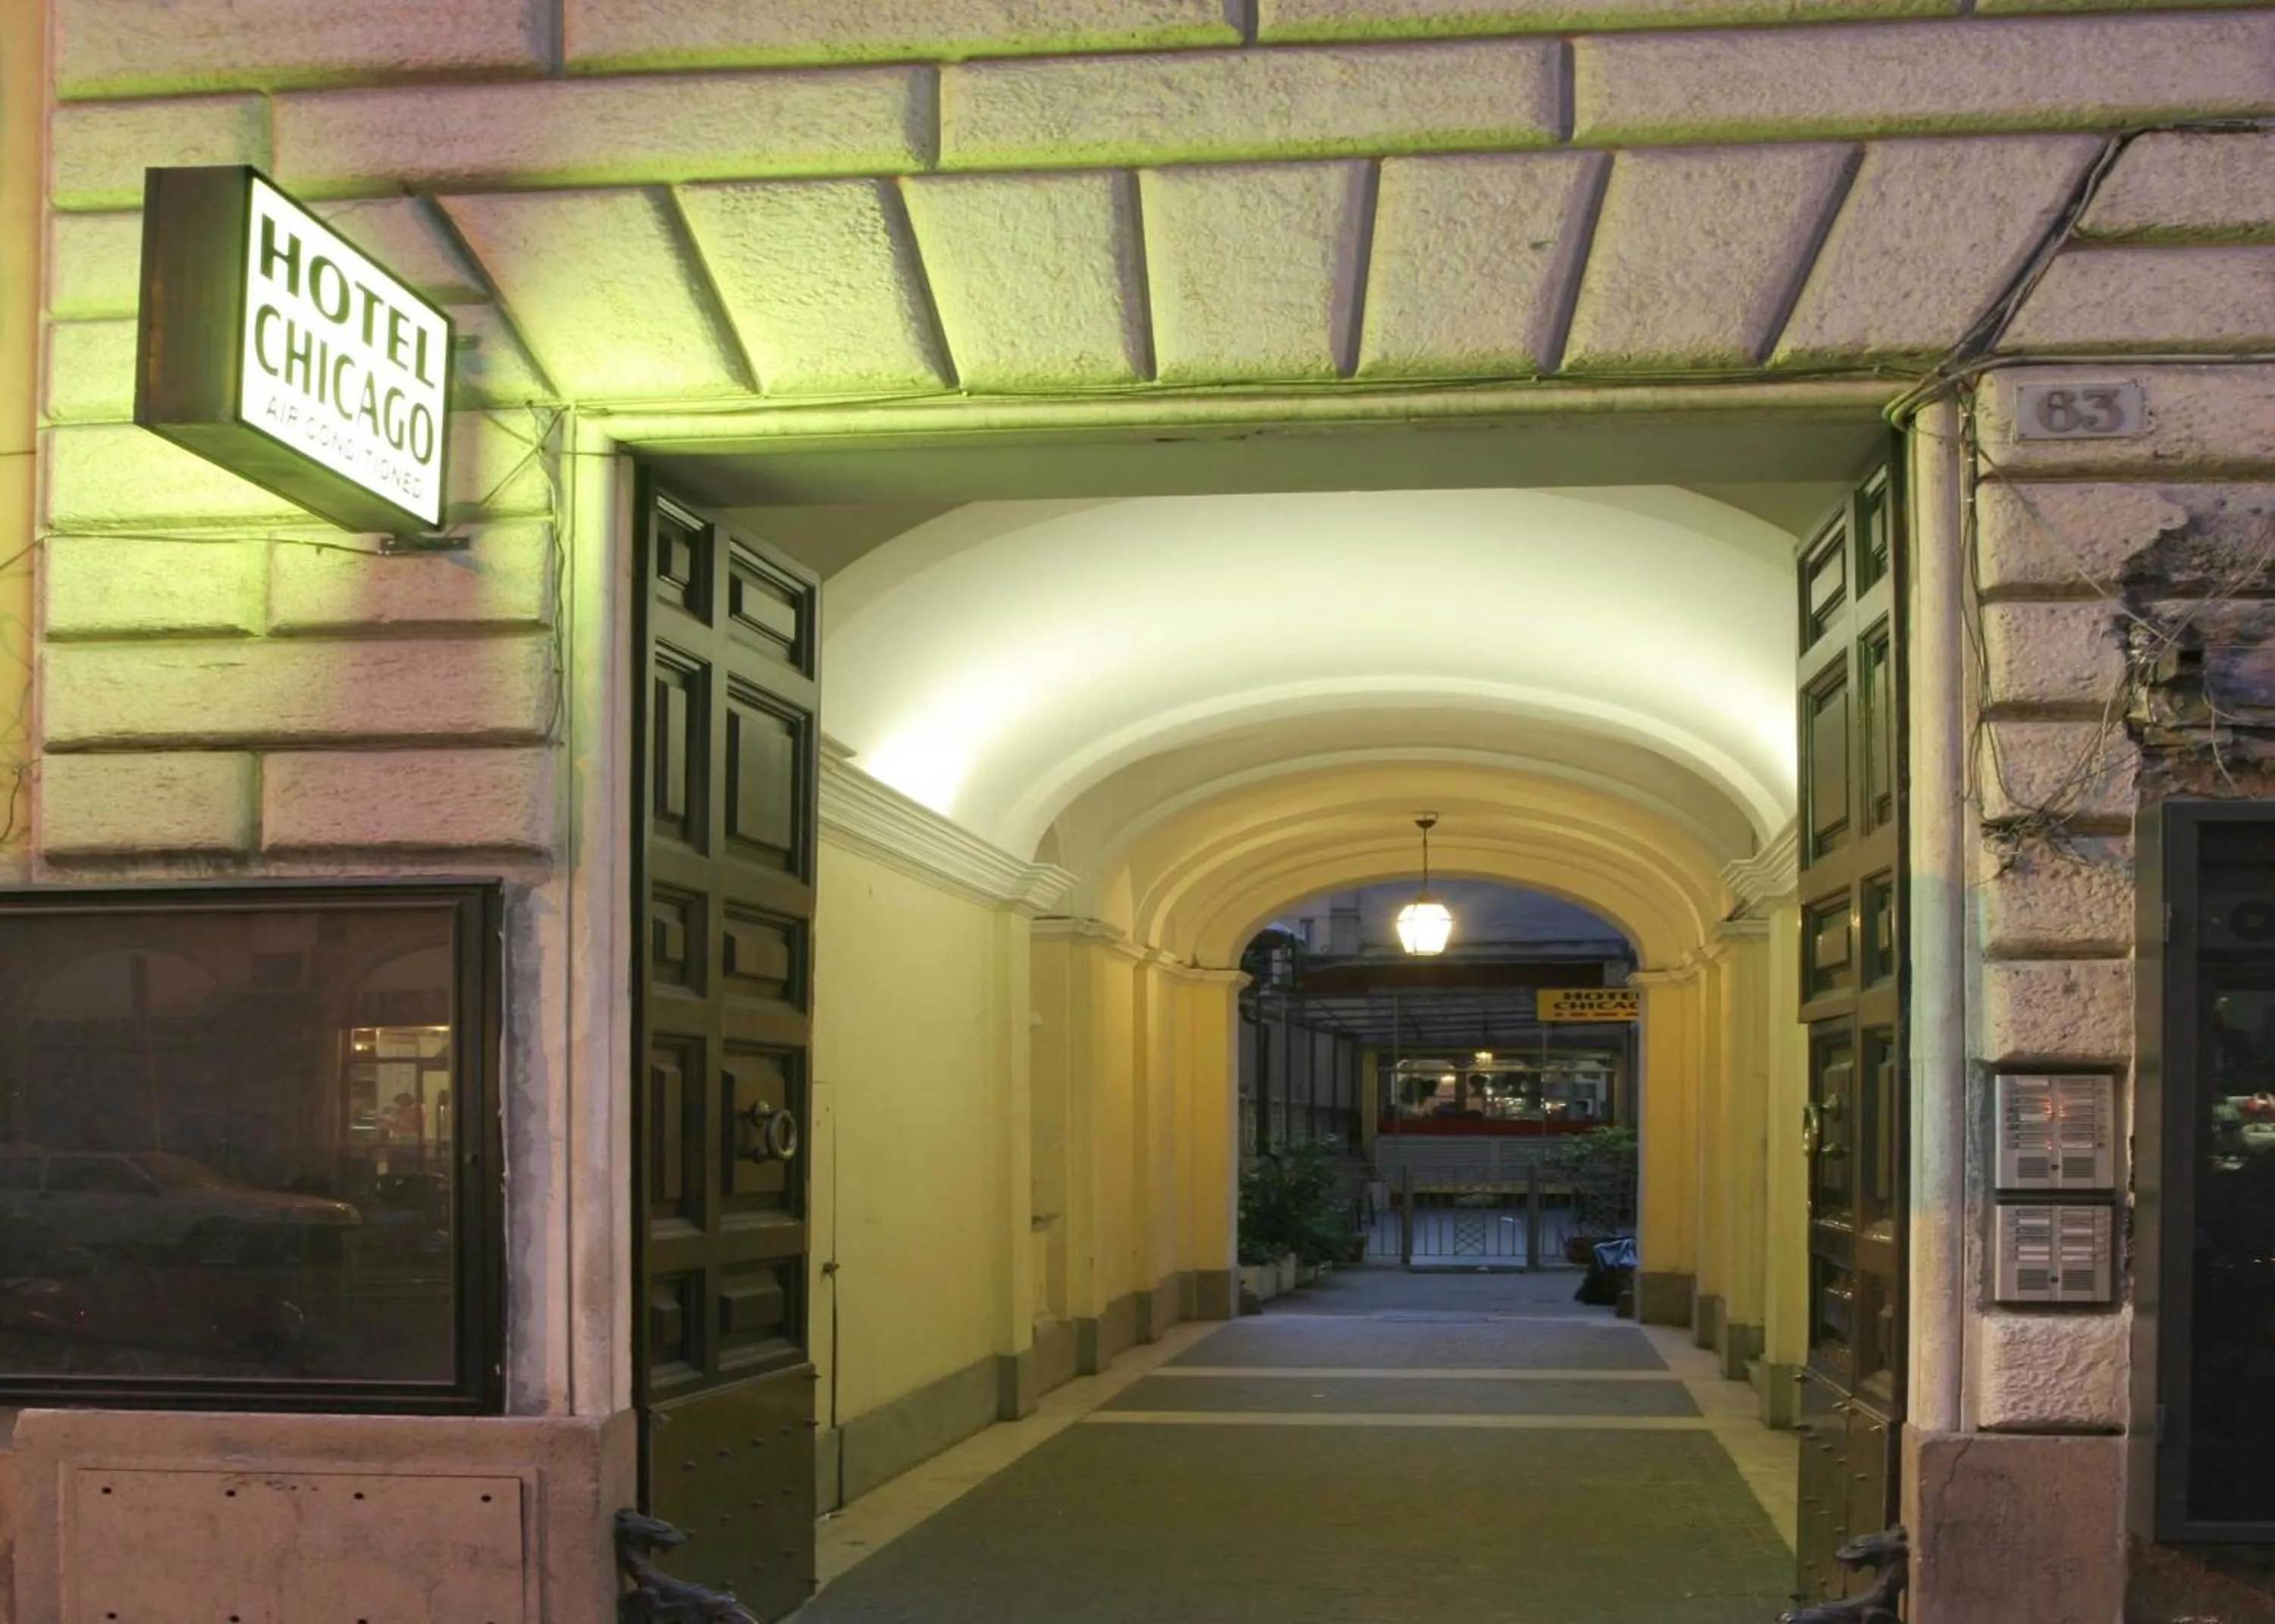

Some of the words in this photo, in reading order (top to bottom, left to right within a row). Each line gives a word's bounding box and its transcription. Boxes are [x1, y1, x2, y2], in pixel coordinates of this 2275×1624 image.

[260, 213, 435, 389] HOTEL
[255, 304, 434, 466] CHICAGO
[266, 394, 300, 426] AIR
[306, 415, 423, 498] CONDITIONED
[2035, 389, 2125, 433] 63
